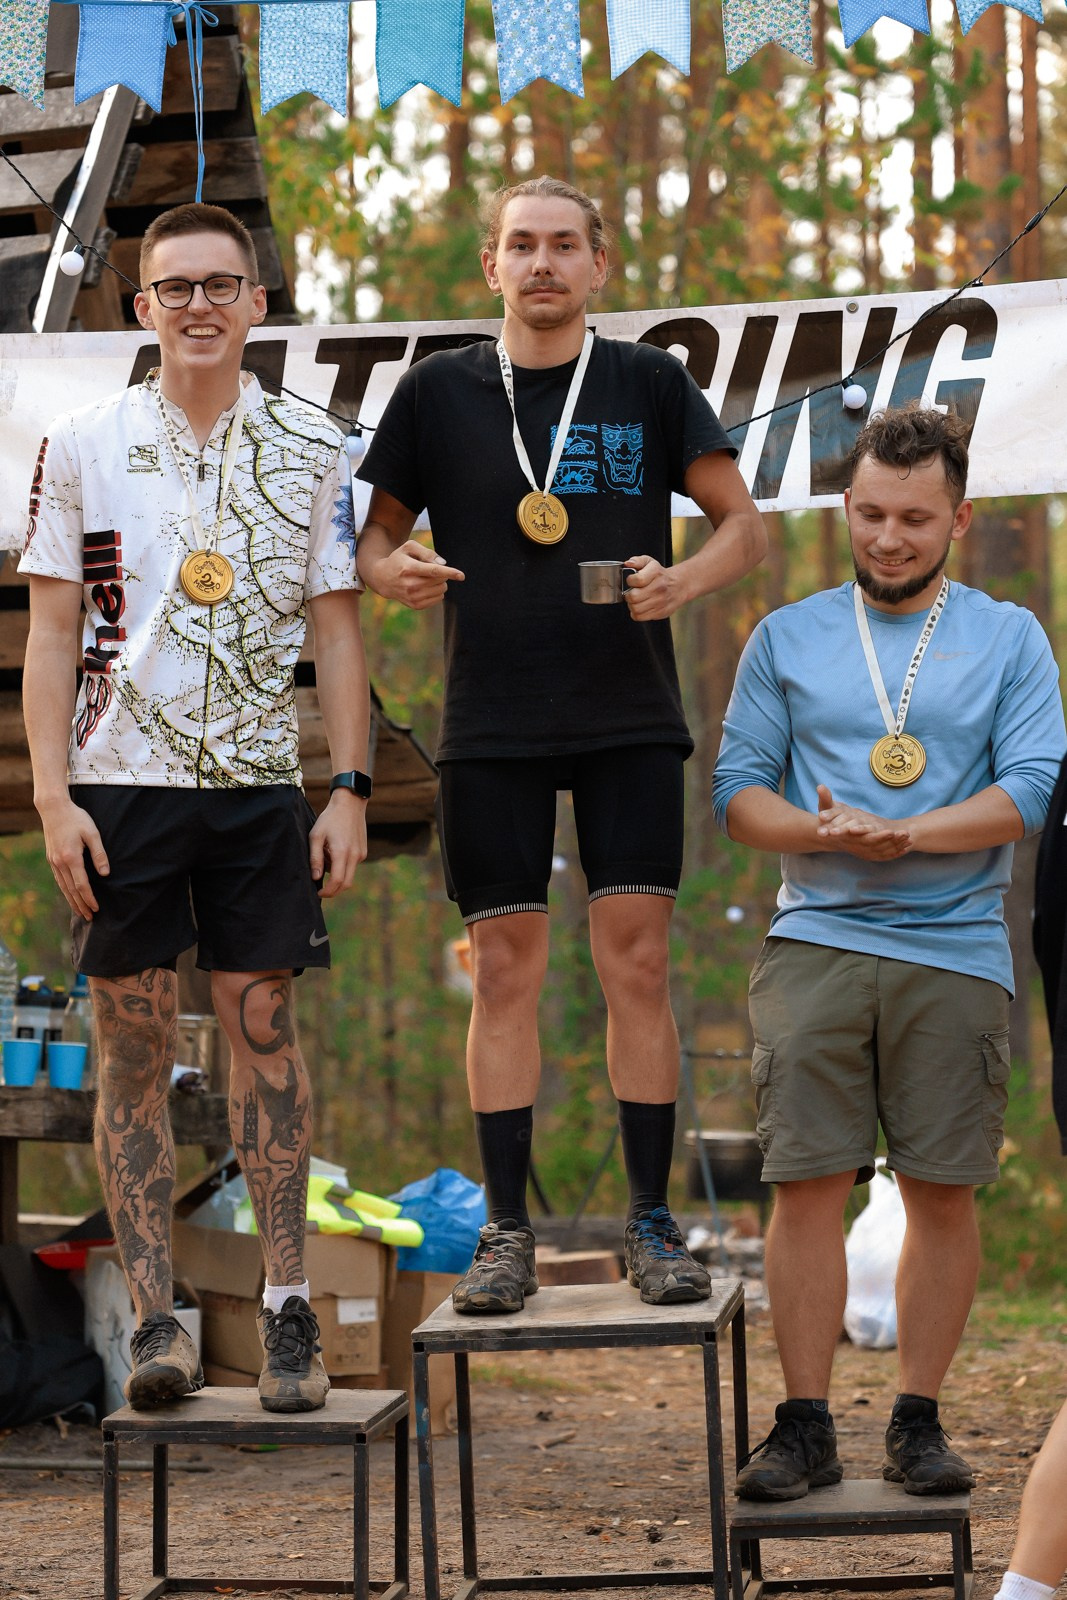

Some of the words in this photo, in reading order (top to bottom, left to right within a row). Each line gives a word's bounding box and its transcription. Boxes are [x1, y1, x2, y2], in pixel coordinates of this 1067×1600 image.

[532, 519, 557, 534] МЕСТО
[540, 511, 549, 527] 1
[193, 578, 221, 594] МЕСТО
[200, 572, 215, 587] 2
[890, 754, 906, 769] 3
[883, 763, 912, 776] МЕСТО
